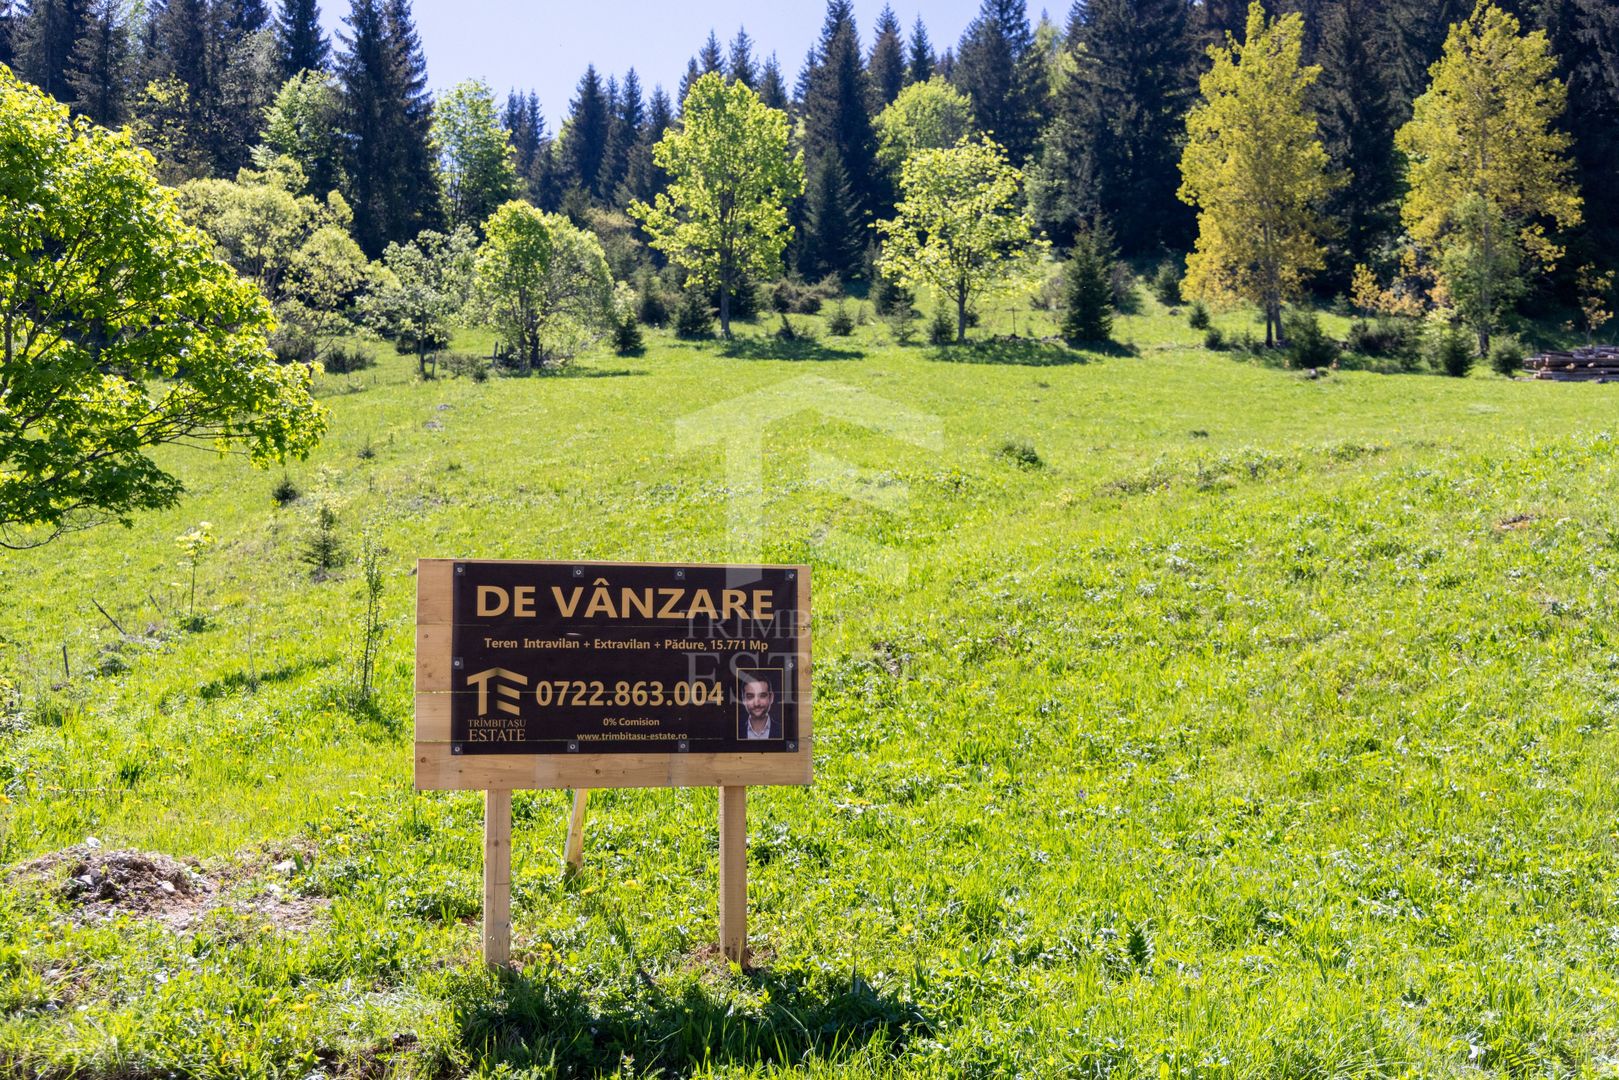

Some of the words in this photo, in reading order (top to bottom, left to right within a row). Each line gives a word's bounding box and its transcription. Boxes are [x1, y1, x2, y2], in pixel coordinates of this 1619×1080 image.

[476, 585, 537, 618] DE
[551, 577, 774, 620] VÂNZARE
[484, 637, 518, 649] Teren
[524, 638, 580, 649] Intravilan
[594, 639, 651, 650] Extravilan
[664, 639, 707, 651] Pădure,
[711, 640, 746, 650] 15.771
[750, 640, 769, 652] Mp
[536, 681, 724, 706] 0722.863.004
[603, 718, 617, 726] 0%
[619, 717, 660, 726] Comision
[469, 729, 526, 742] ESTATE
[577, 732, 688, 741] www.trimbitasu-estate.ro
